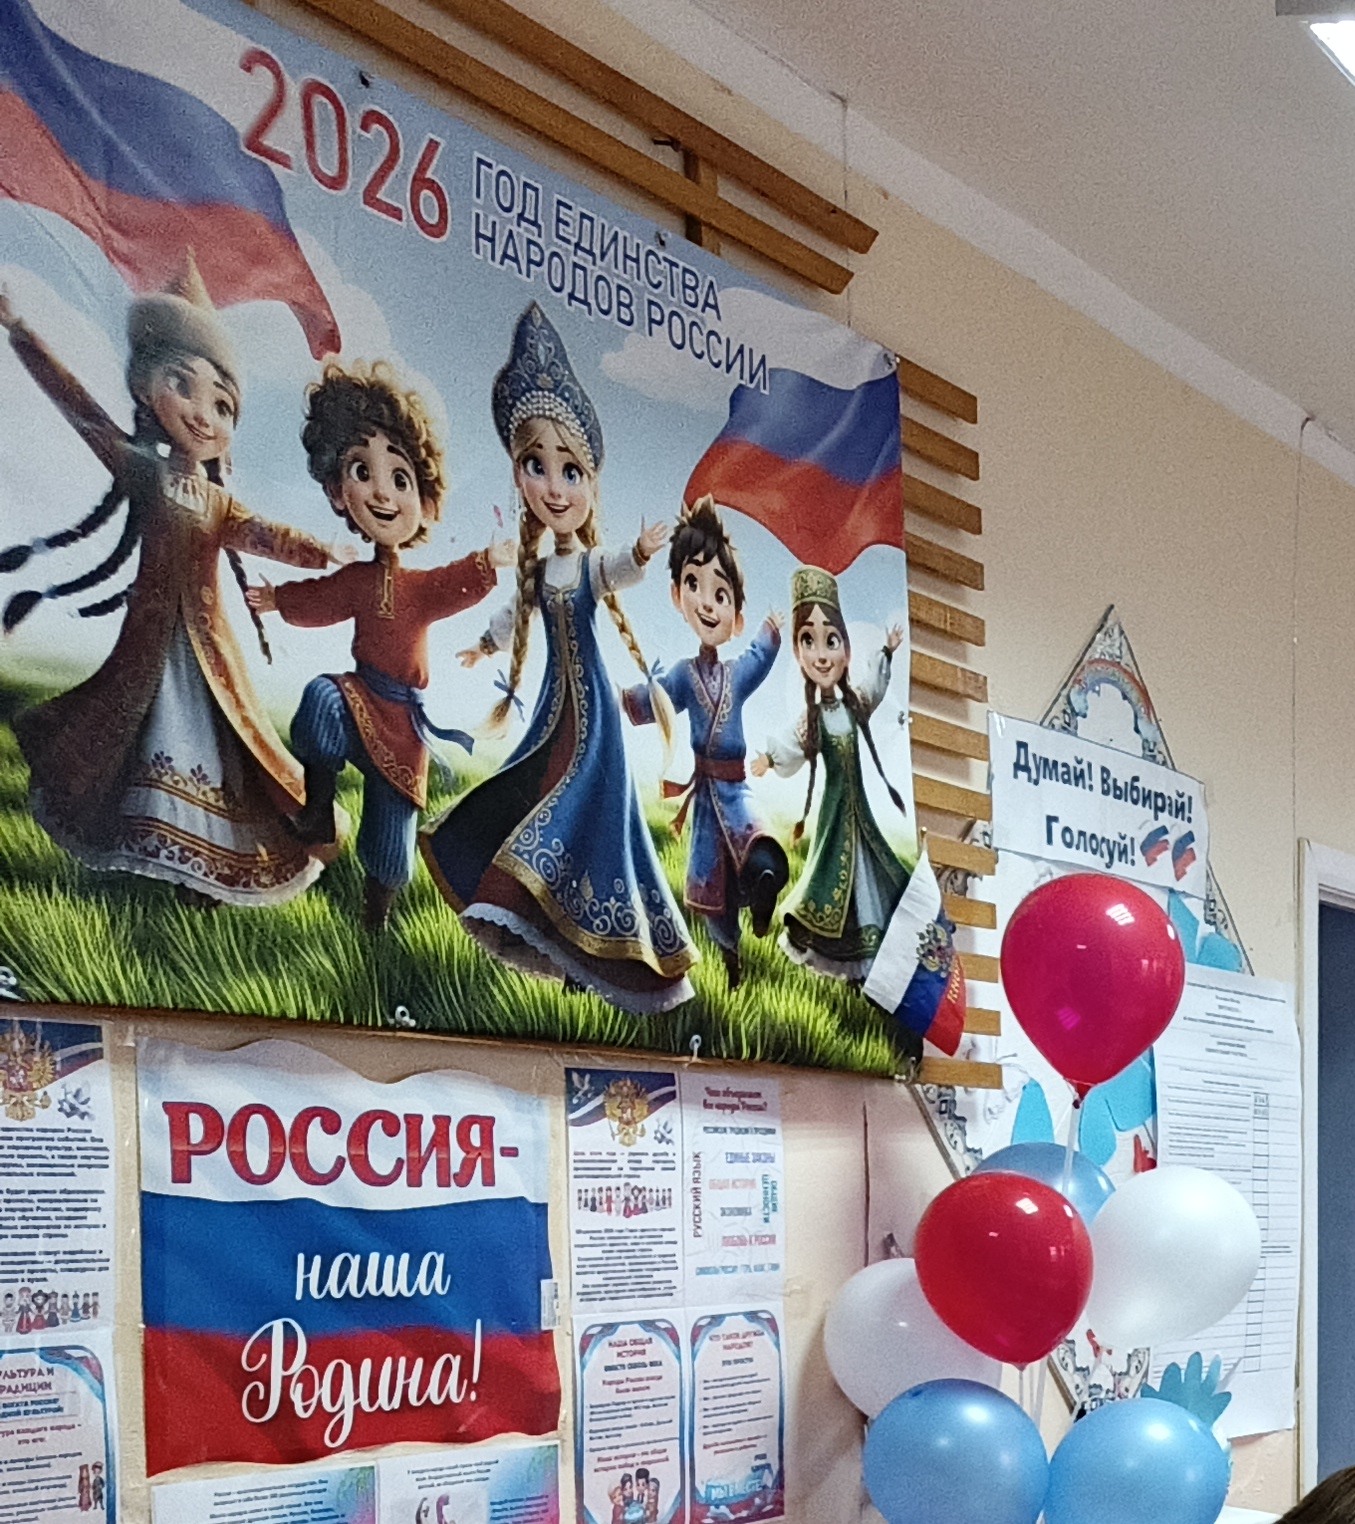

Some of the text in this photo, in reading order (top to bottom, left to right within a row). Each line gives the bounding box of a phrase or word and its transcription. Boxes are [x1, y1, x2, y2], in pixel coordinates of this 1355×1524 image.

[239, 46, 449, 240] 2026
[474, 211, 769, 392] НАРОДОВ РОССИИ
[475, 156, 722, 321] ГОД ЕДИНСТВА
[1012, 740, 1094, 792] Думай!
[690, 1151, 702, 1238] РУССКИЙ ЯЗЫК
[295, 1250, 452, 1301] наша
[240, 1317, 483, 1448] Родина!
